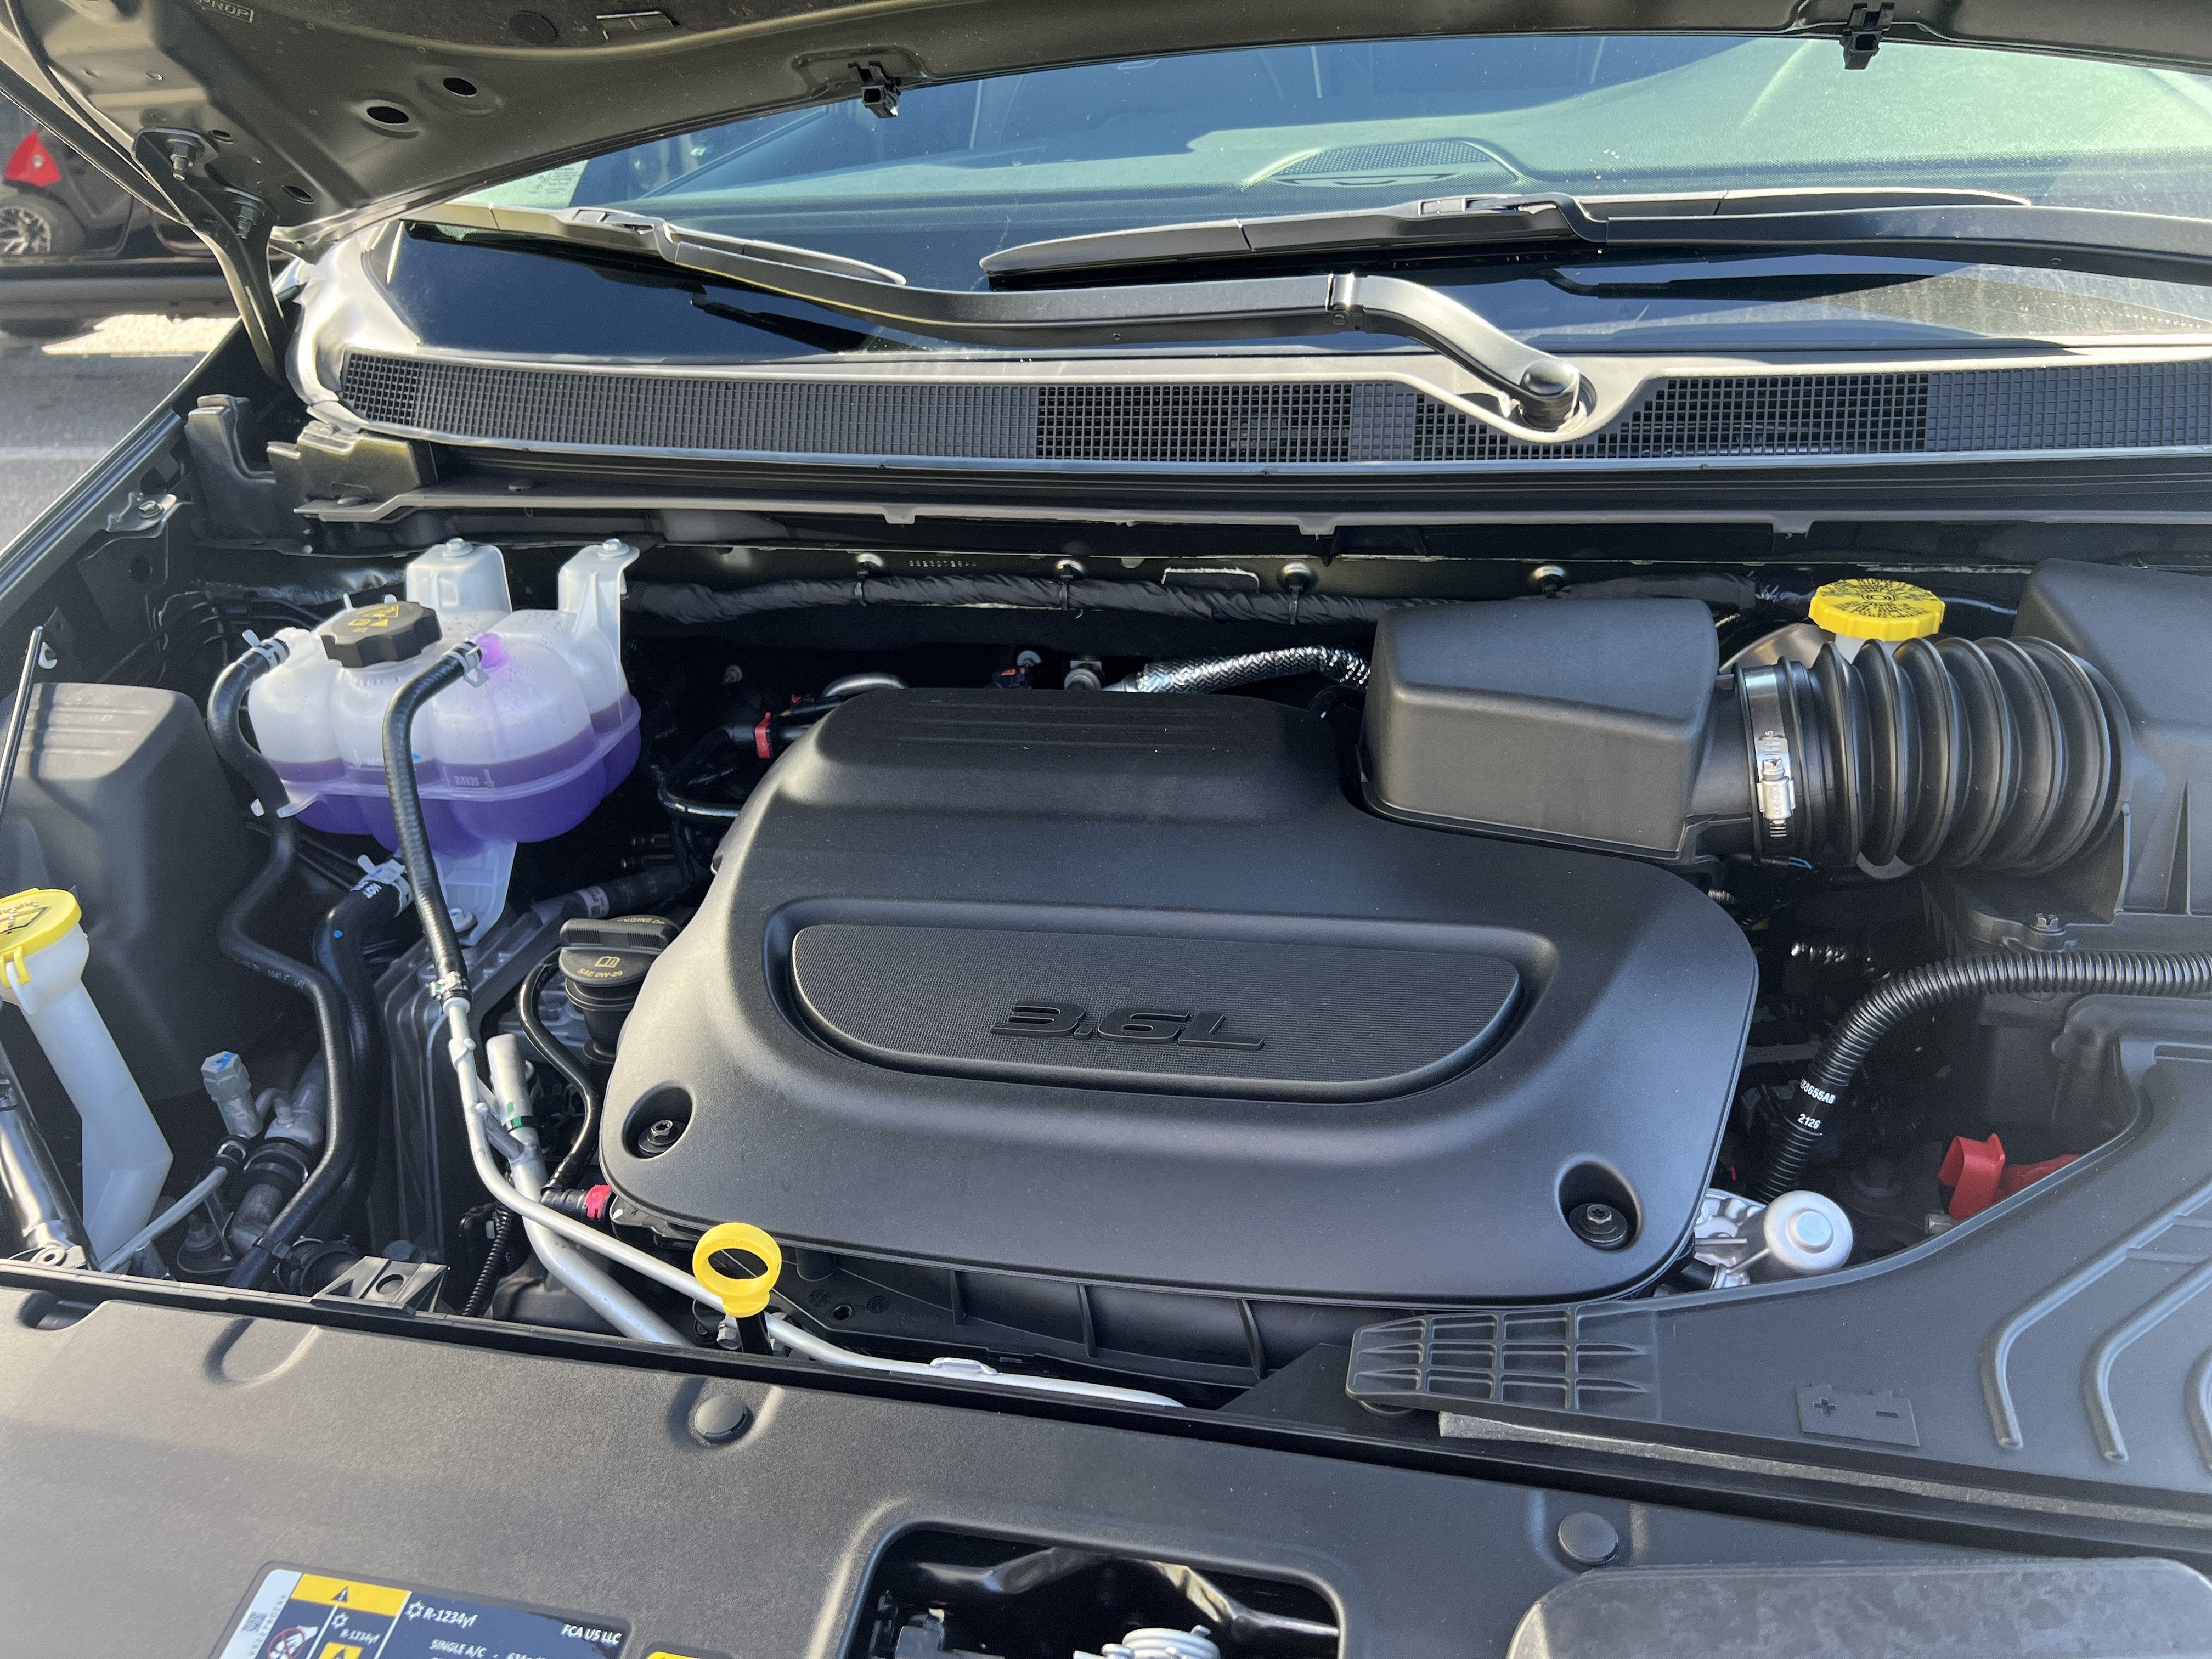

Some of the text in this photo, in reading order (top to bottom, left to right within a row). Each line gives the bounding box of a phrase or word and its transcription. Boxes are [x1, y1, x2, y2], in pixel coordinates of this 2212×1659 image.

[577, 968, 596, 977] SAE
[990, 1000, 1265, 1051] 3.6L
[1797, 1113, 1821, 1130] 2126
[561, 1624, 622, 1645] FCA US LLC
[428, 1639, 467, 1655] SINGLE
[465, 1645, 488, 1658] A/C
